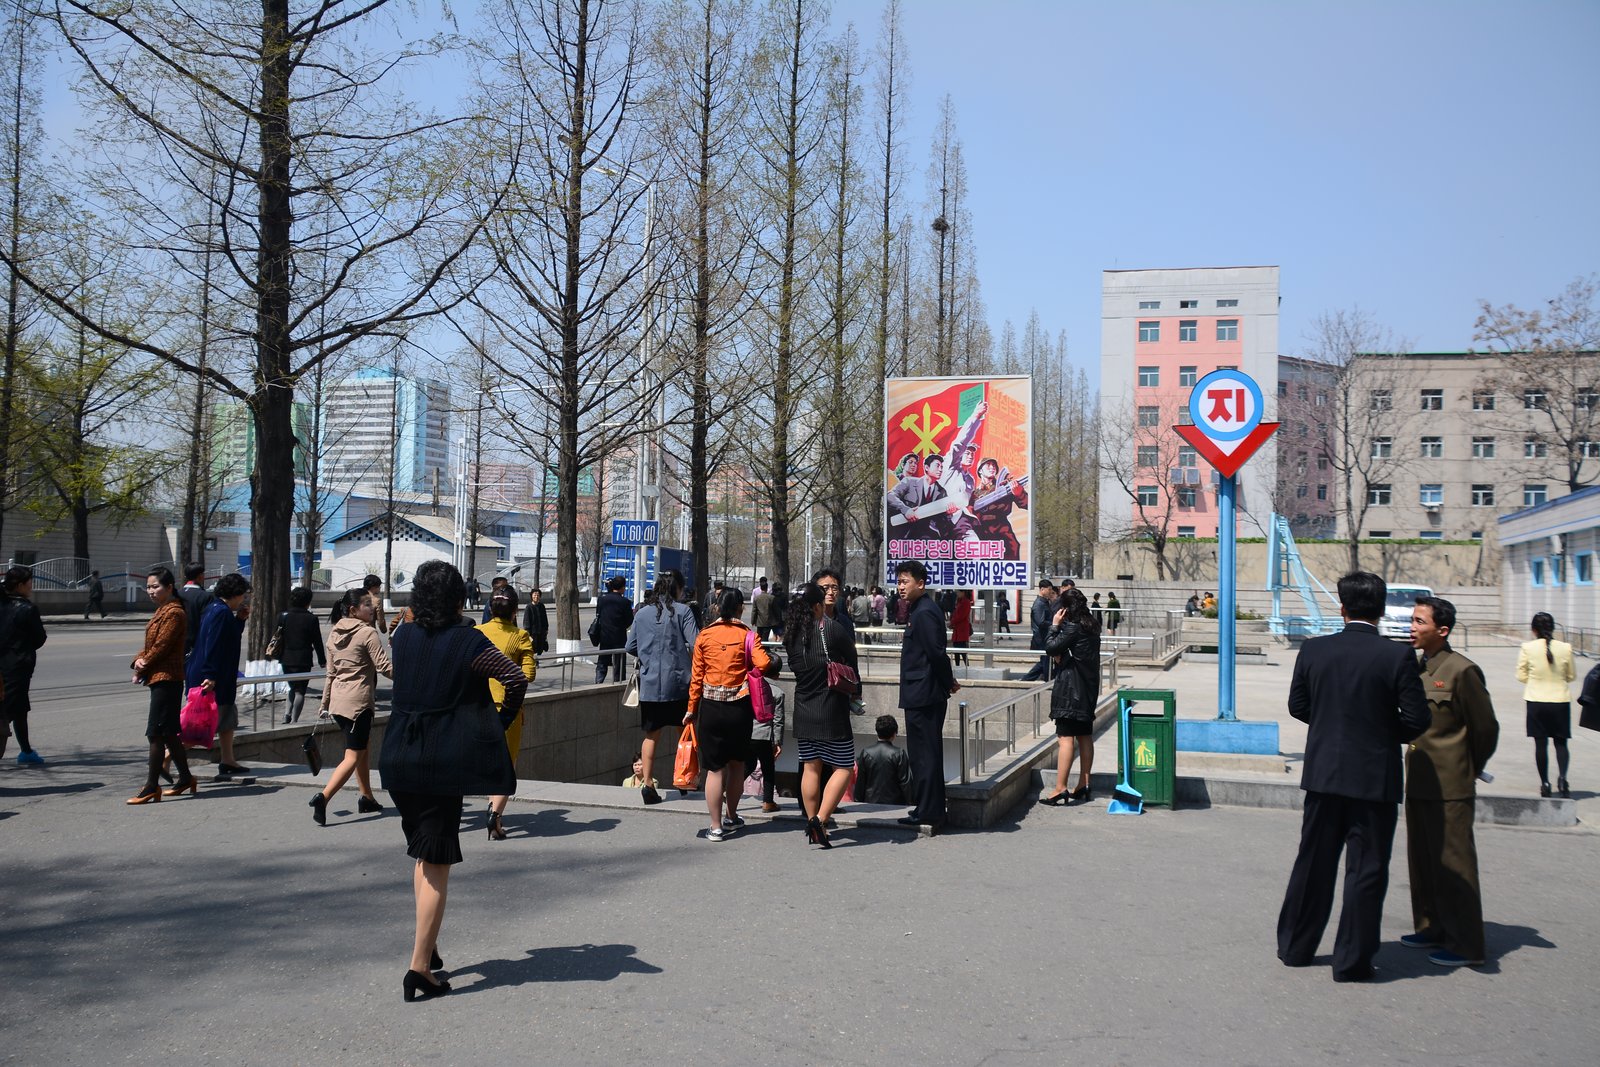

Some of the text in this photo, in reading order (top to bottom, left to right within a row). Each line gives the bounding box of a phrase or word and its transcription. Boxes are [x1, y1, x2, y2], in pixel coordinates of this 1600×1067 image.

[1207, 389, 1245, 422] 지
[615, 524, 656, 541] 70 60 40
[889, 540, 1005, 559] 위대한 당의 령도따라
[956, 561, 990, 586] 향하여
[993, 562, 1027, 586] 앞으로
